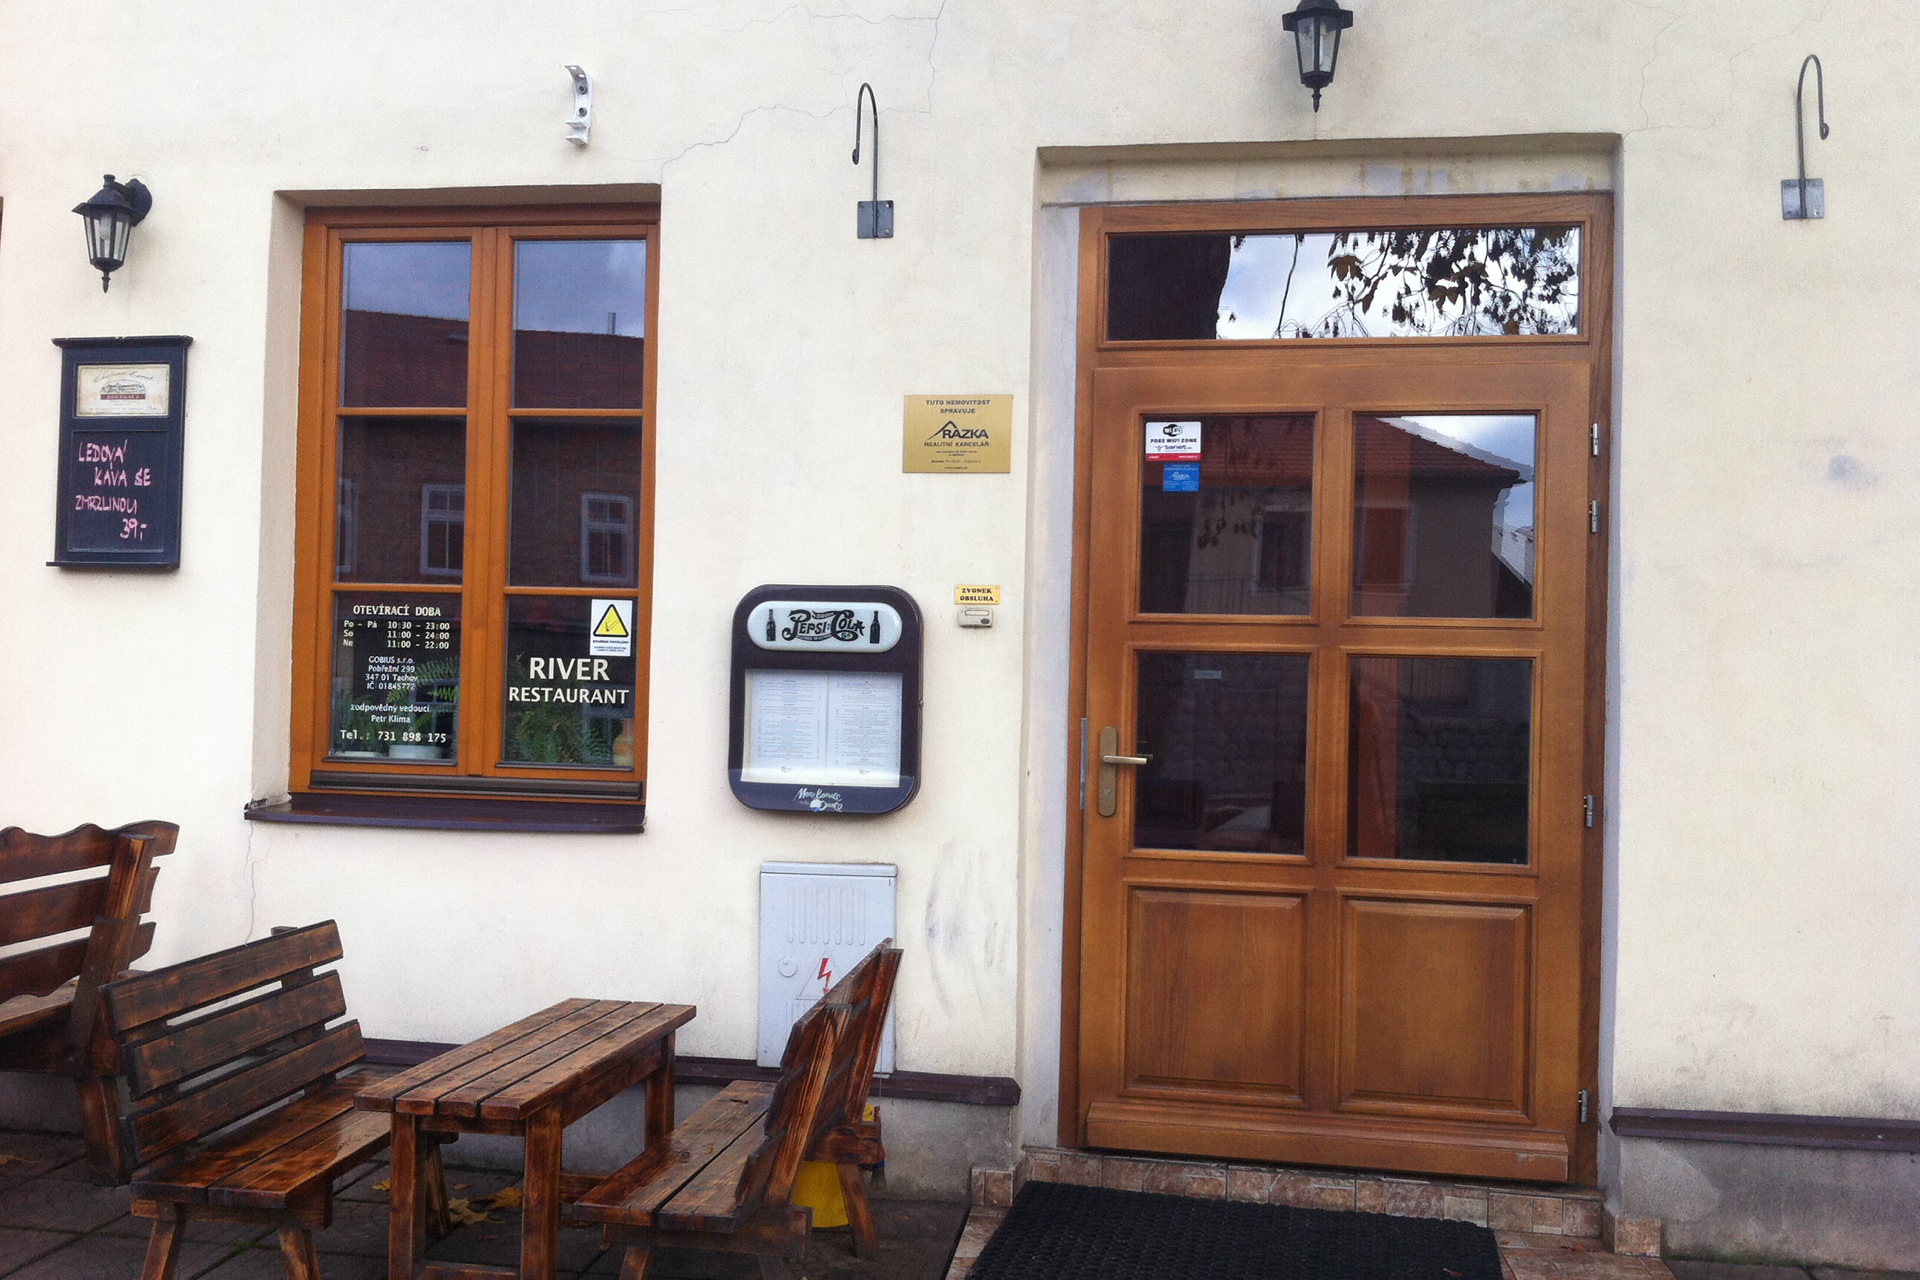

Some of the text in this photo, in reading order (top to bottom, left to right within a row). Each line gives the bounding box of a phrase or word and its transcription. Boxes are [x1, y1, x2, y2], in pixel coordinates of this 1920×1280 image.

[353, 603, 441, 617] OTEVÍRACÍ DOBA
[344, 620, 354, 628] Po
[367, 620, 378, 628] Pá
[387, 621, 412, 630] 10:30
[425, 622, 450, 630] 23:00
[343, 629, 354, 637] So
[387, 630, 412, 639] 11:00
[425, 631, 450, 640] 24:00
[343, 639, 354, 647] Ne
[387, 640, 411, 648] 11:00
[368, 656, 395, 664] GOBIUS
[400, 665, 415, 673] 299
[529, 657, 610, 681] RIVER
[365, 673, 379, 681] 347
[392, 674, 418, 682] Tachov
[508, 686, 630, 704] RESTAURANT
[350, 703, 430, 713] zodpovědný vedoucí
[371, 714, 387, 723] Petr
[377, 731, 396, 741] 731
[402, 732, 422, 742] 898
[427, 733, 447, 743] 175
